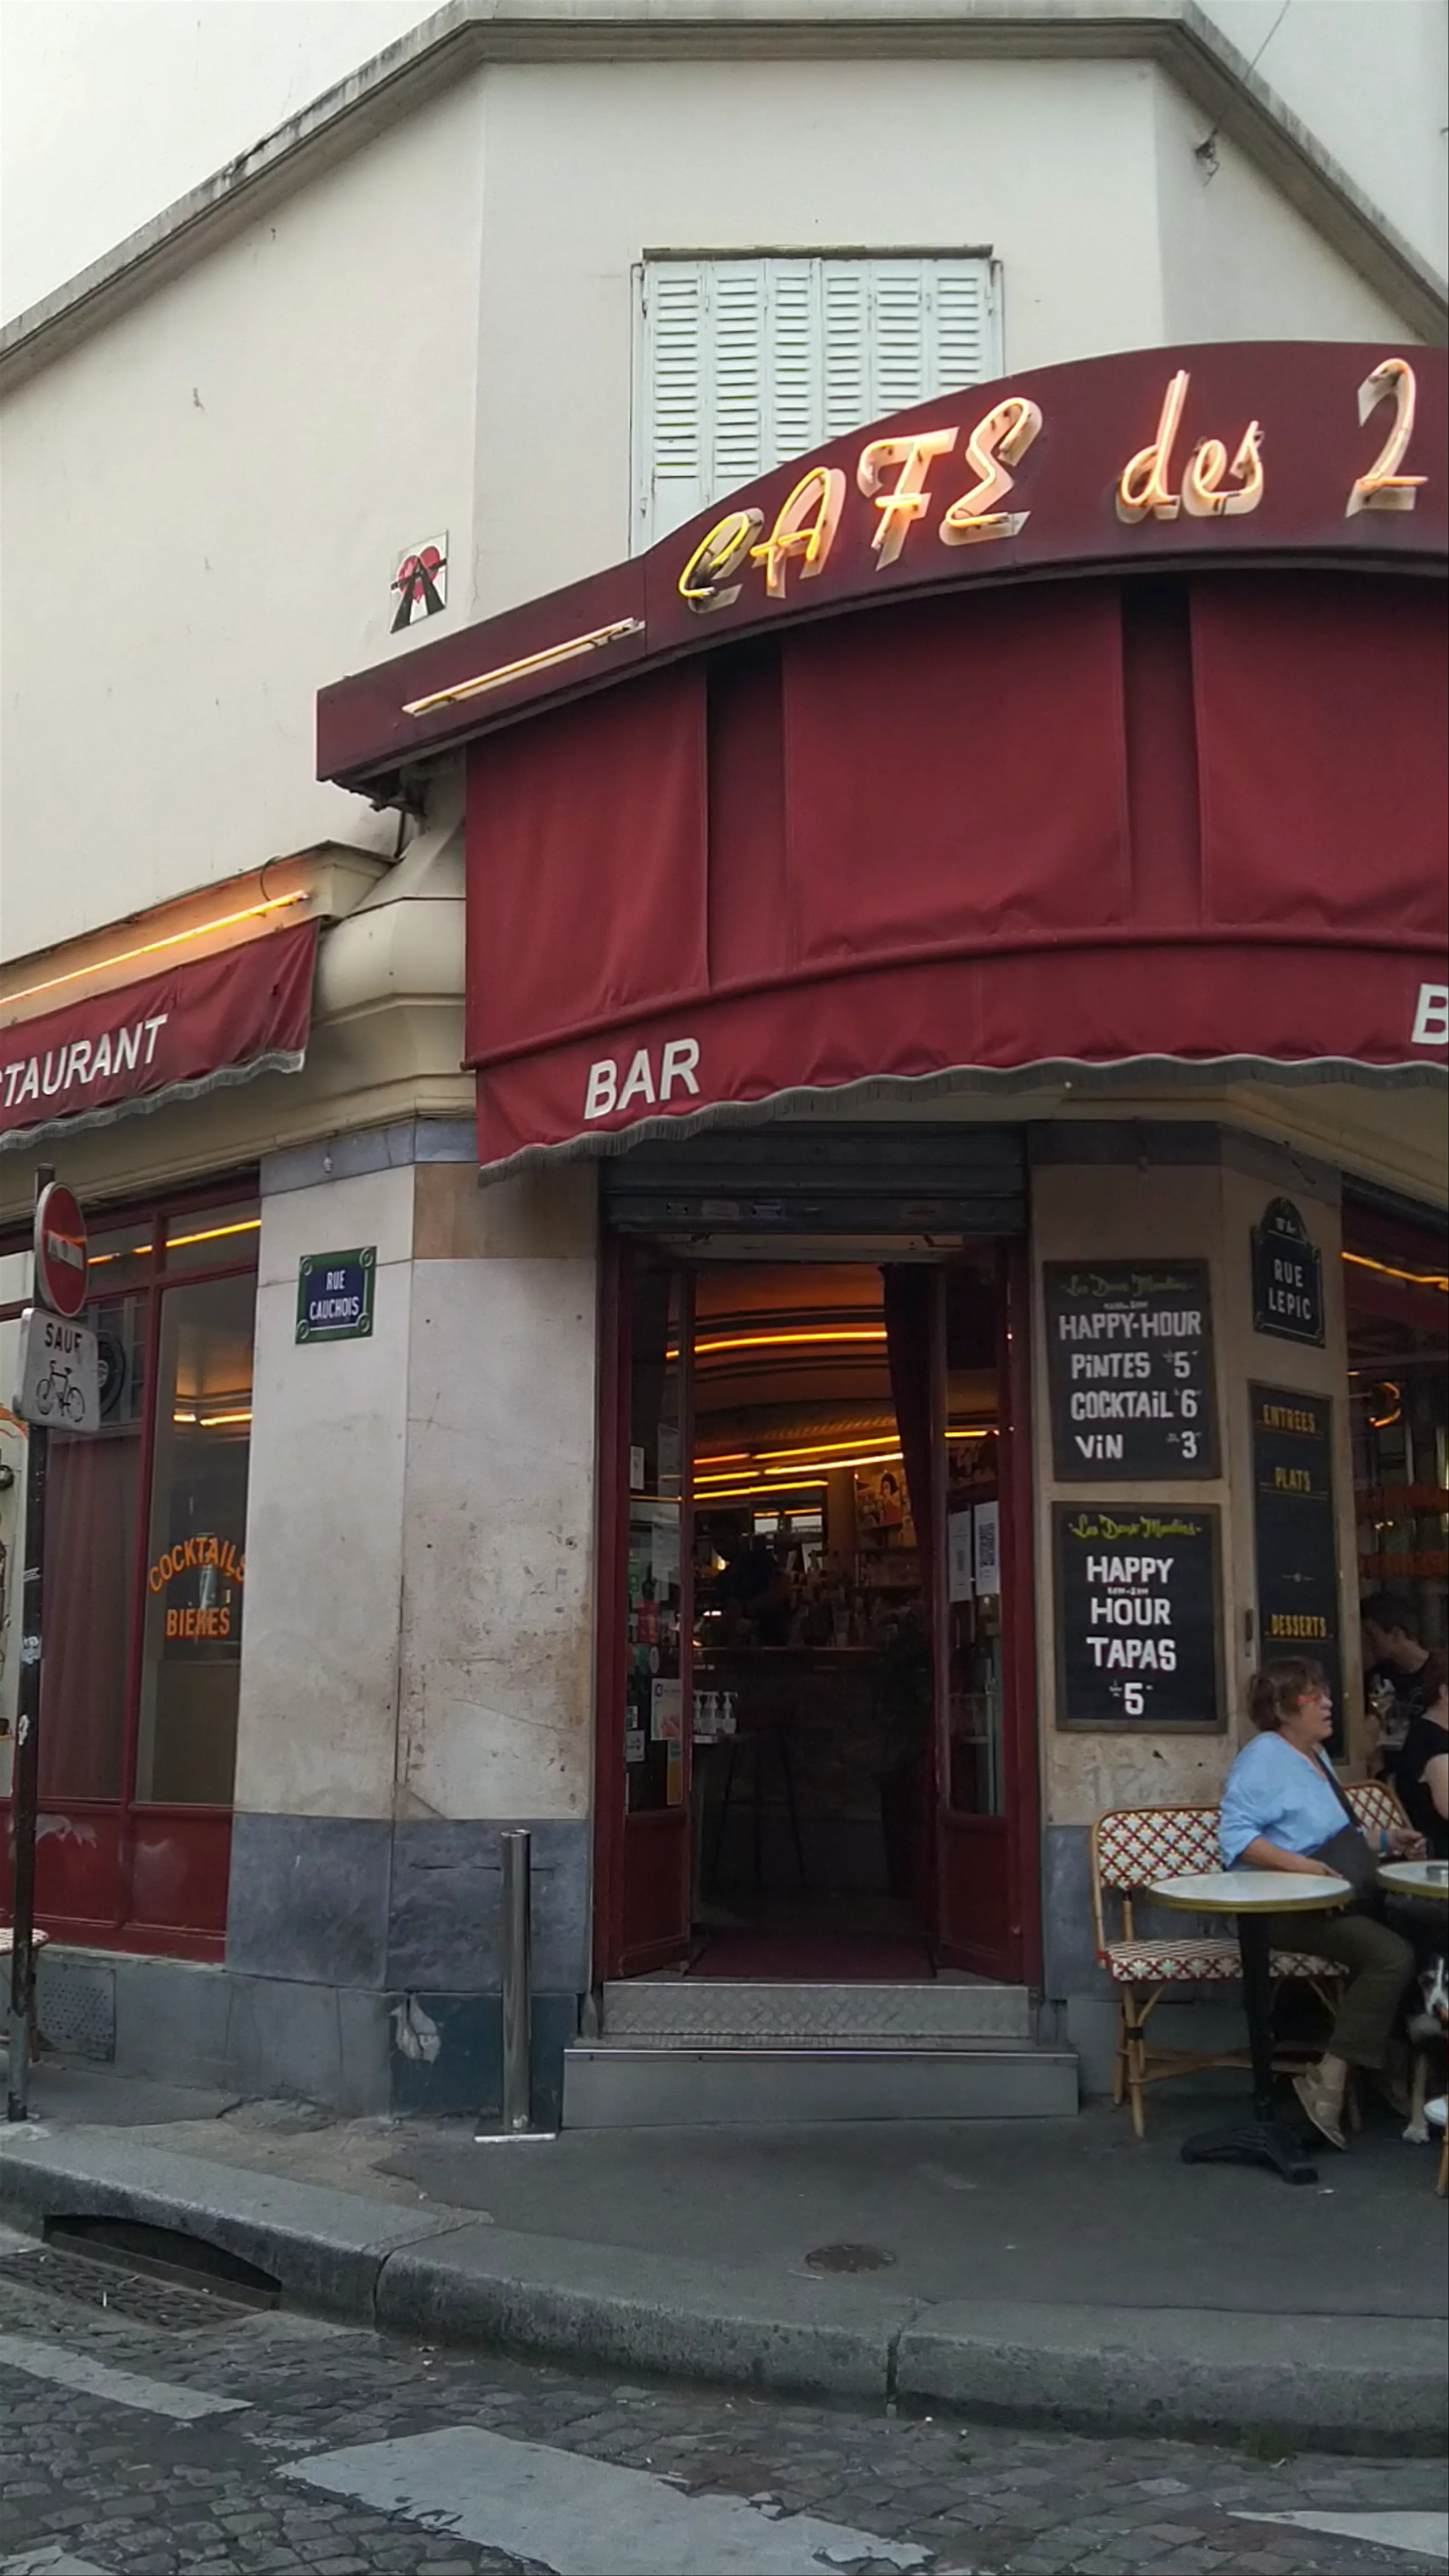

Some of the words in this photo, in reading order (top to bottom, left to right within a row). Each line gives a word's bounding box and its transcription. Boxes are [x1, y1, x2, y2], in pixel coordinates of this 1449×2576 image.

[1116, 369, 1266, 524] des
[1345, 358, 1429, 518] 2
[0, 1013, 169, 1107] TAURANT
[584, 1038, 700, 1120] BAR
[326, 1269, 346, 1291] RUE
[1274, 1258, 1303, 1288] RUE
[309, 1296, 360, 1320] CAUCHOIS
[1268, 1287, 1311, 1320] LEPIC
[44, 1322, 83, 1354] SAUF
[1059, 1310, 1202, 1340] HAPPY-HOUR
[1173, 1351, 1191, 1378] 5
[1181, 1389, 1198, 1419] 6
[1181, 1431, 1198, 1459] 3
[1274, 1466, 1311, 1492] PLATS
[149, 1536, 245, 1592] COCKTAILS
[1086, 1555, 1174, 1584] HAPPY
[1091, 1597, 1172, 1626] HOUR
[1271, 1613, 1326, 1638] DESSERTS
[1086, 1637, 1177, 1672] TAPAS
[1124, 1682, 1145, 1715] 5
